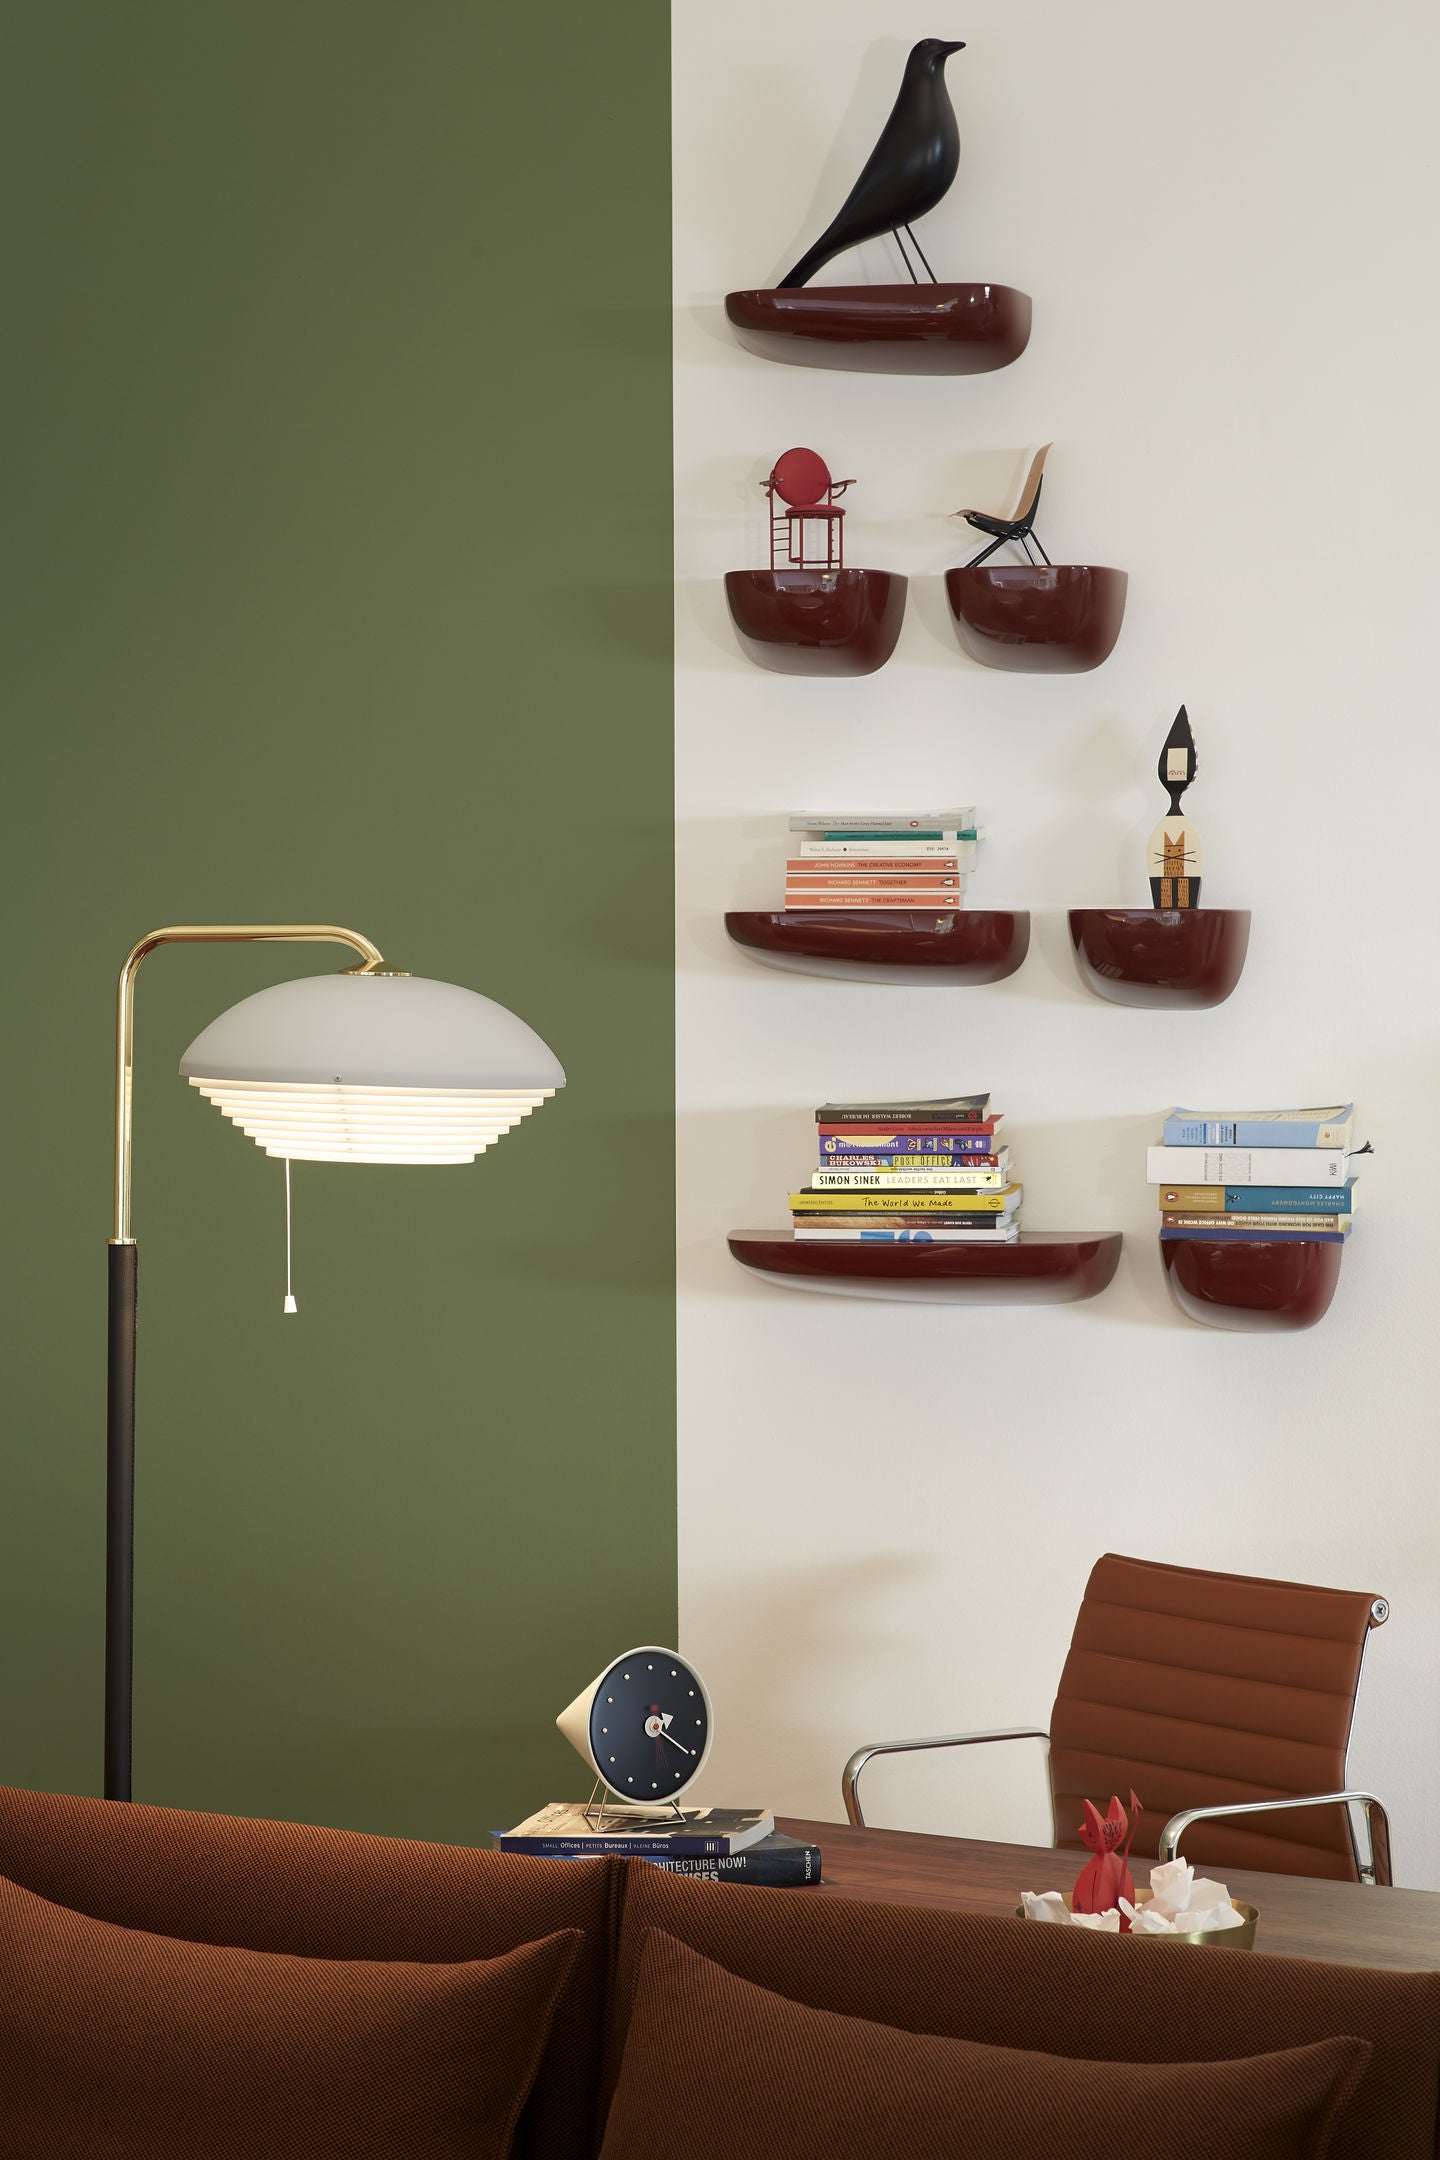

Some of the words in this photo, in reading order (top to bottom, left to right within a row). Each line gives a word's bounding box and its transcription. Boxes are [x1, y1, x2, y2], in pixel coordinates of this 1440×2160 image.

[894, 1156, 915, 1166] POST
[920, 1155, 950, 1166] OFFICE
[819, 1175, 850, 1185] SIMON
[854, 1175, 880, 1185] SINEK
[886, 1176, 929, 1184] LEADERS
[933, 1176, 953, 1184] EAT
[954, 1176, 977, 1184] LAST
[862, 1197, 879, 1207] The
[882, 1199, 907, 1207] World
[929, 1199, 953, 1207] Made
[718, 1856, 746, 1869] NOW!
